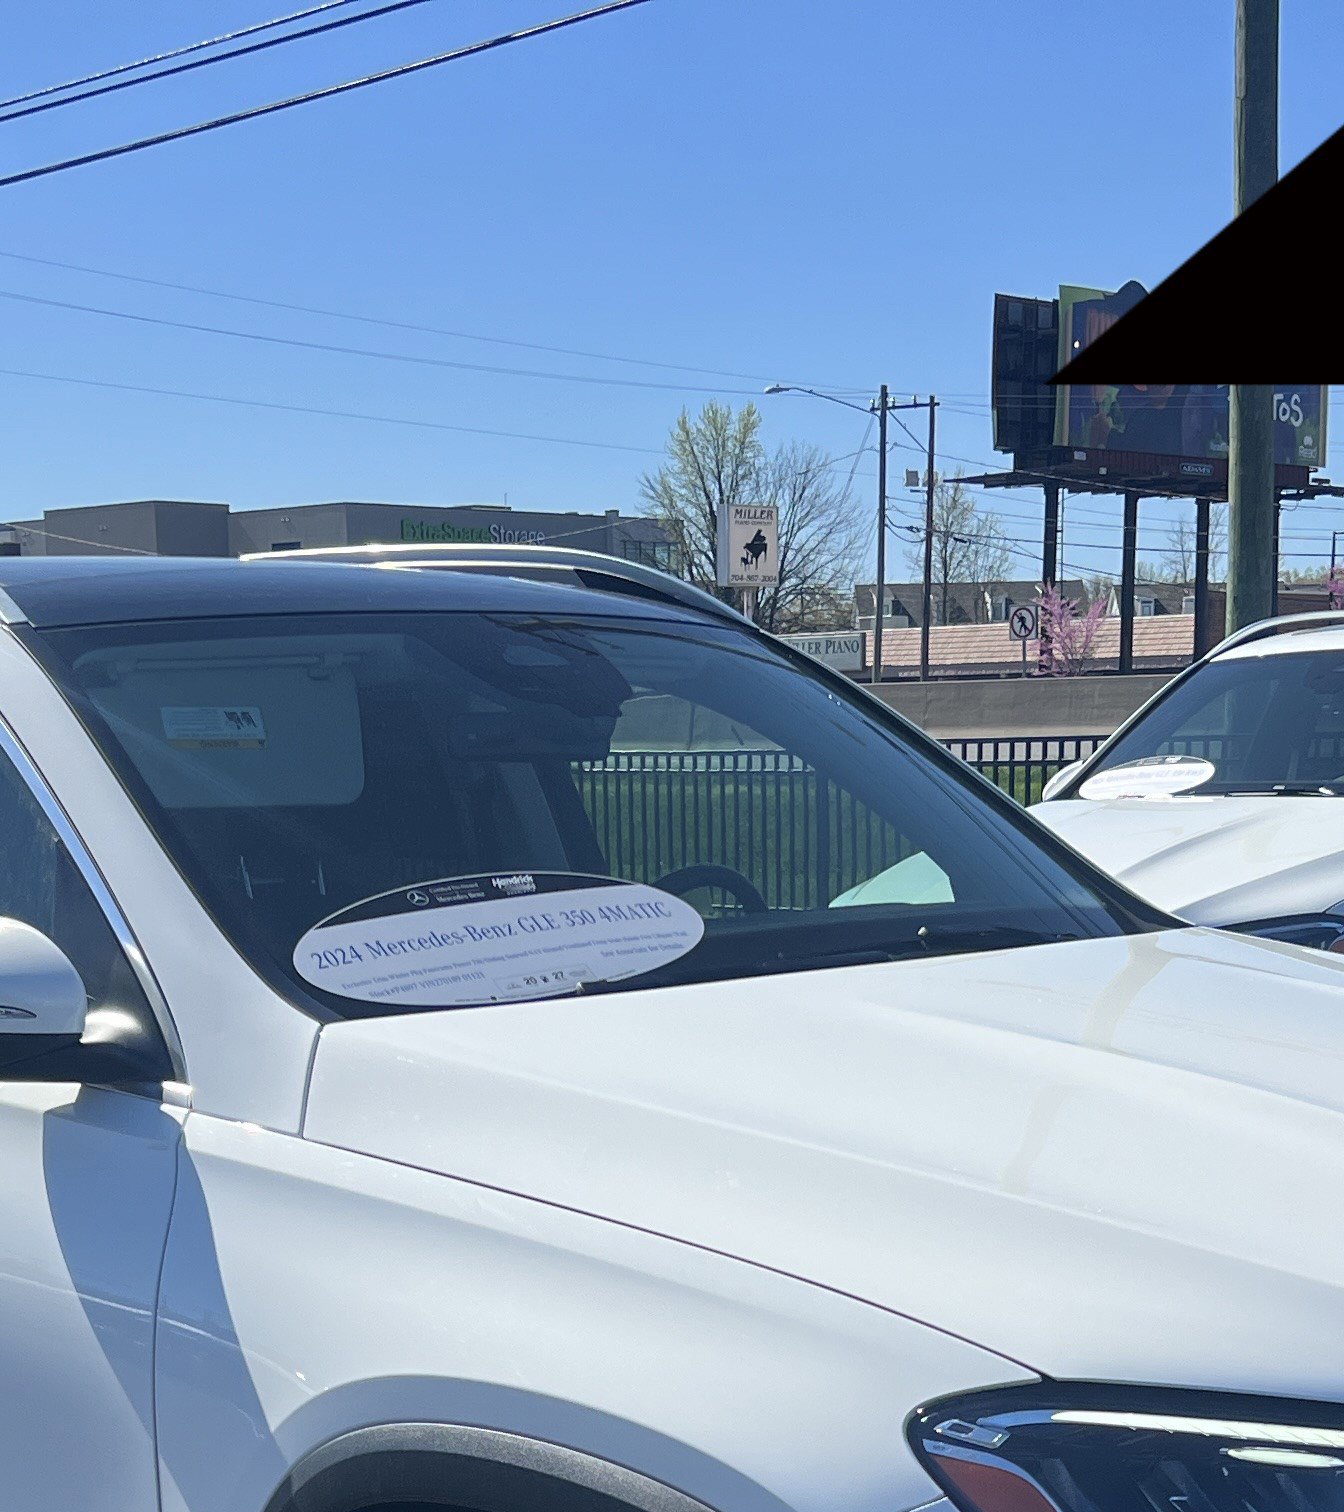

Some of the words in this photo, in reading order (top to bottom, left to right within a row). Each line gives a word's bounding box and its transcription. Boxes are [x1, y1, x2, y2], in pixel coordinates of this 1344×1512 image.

[733, 508, 775, 520] MILLER
[825, 640, 860, 655] PIANO
[310, 945, 363, 970] 2024
[365, 922, 518, 960] Mercedes-Benz
[518, 913, 561, 934] GLE
[559, 908, 596, 927] 350
[598, 901, 673, 923] 4MATIC
